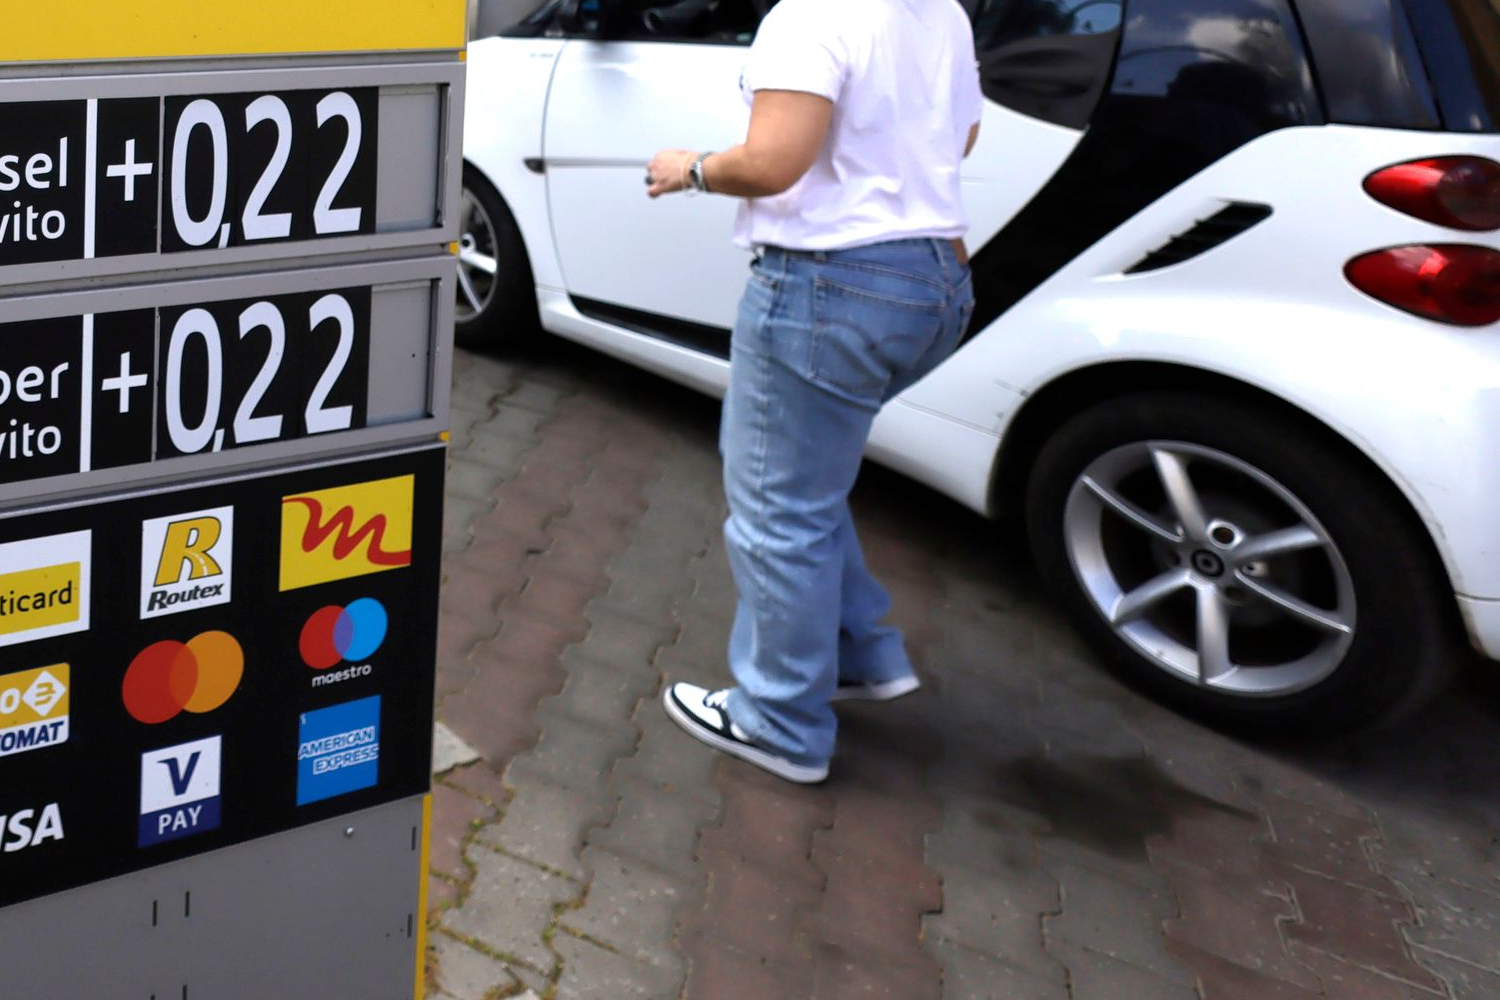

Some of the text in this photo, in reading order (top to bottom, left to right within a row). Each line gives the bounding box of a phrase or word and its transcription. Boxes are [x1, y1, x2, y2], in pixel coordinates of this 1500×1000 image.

[170, 91, 363, 249] 0,22
[165, 293, 355, 453] 0,22
[146, 582, 225, 613] Routex
[312, 663, 372, 687] maestro
[298, 725, 376, 760] AMERICAN
[313, 743, 380, 776] EXPRESS
[157, 751, 201, 797] V
[158, 804, 202, 836] PAY
